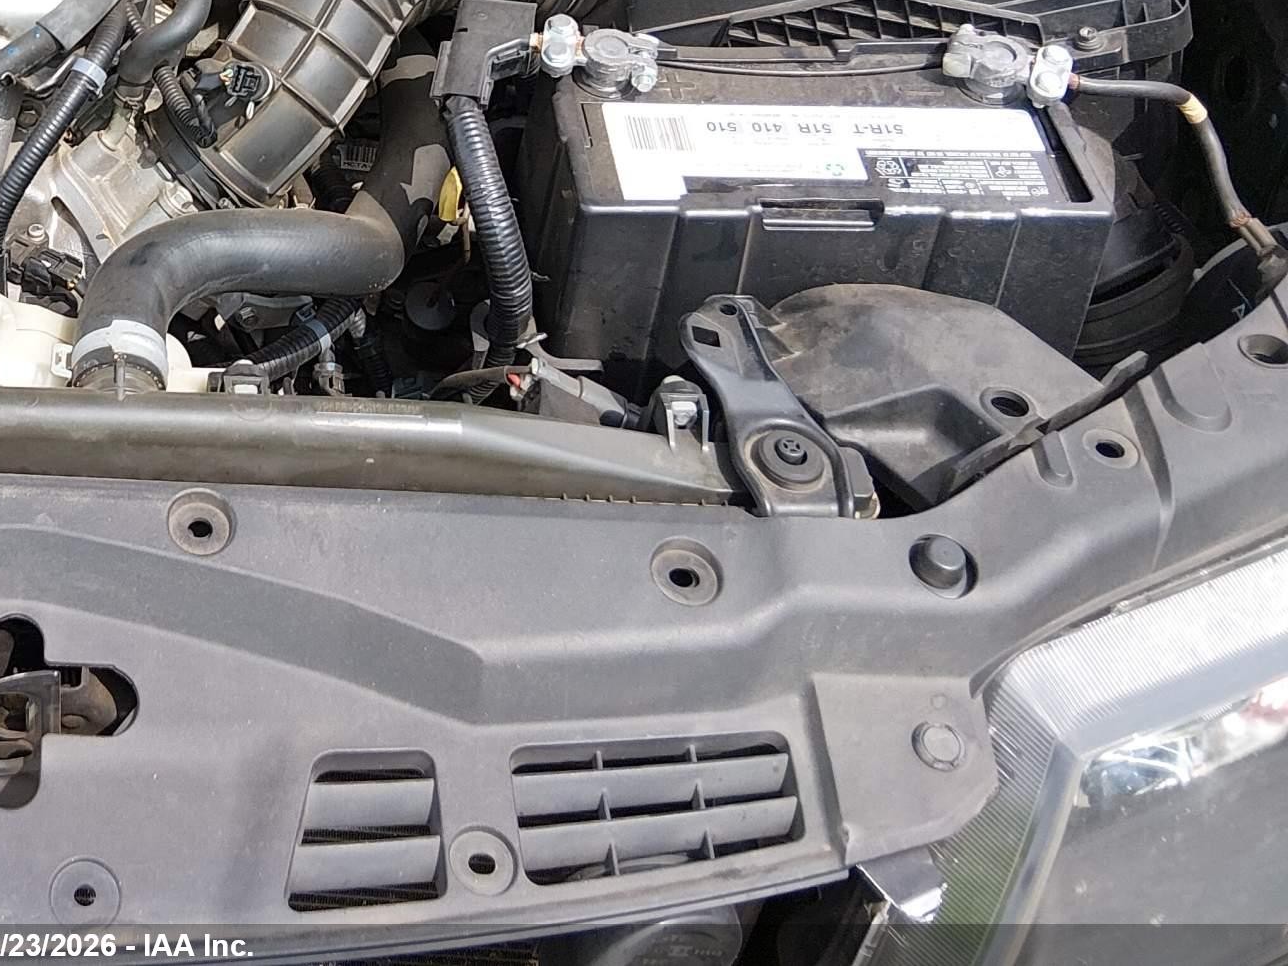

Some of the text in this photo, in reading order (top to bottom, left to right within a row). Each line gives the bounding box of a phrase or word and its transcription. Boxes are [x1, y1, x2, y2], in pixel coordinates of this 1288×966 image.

[707, 121, 903, 134] 51R-T 51R 410 510
